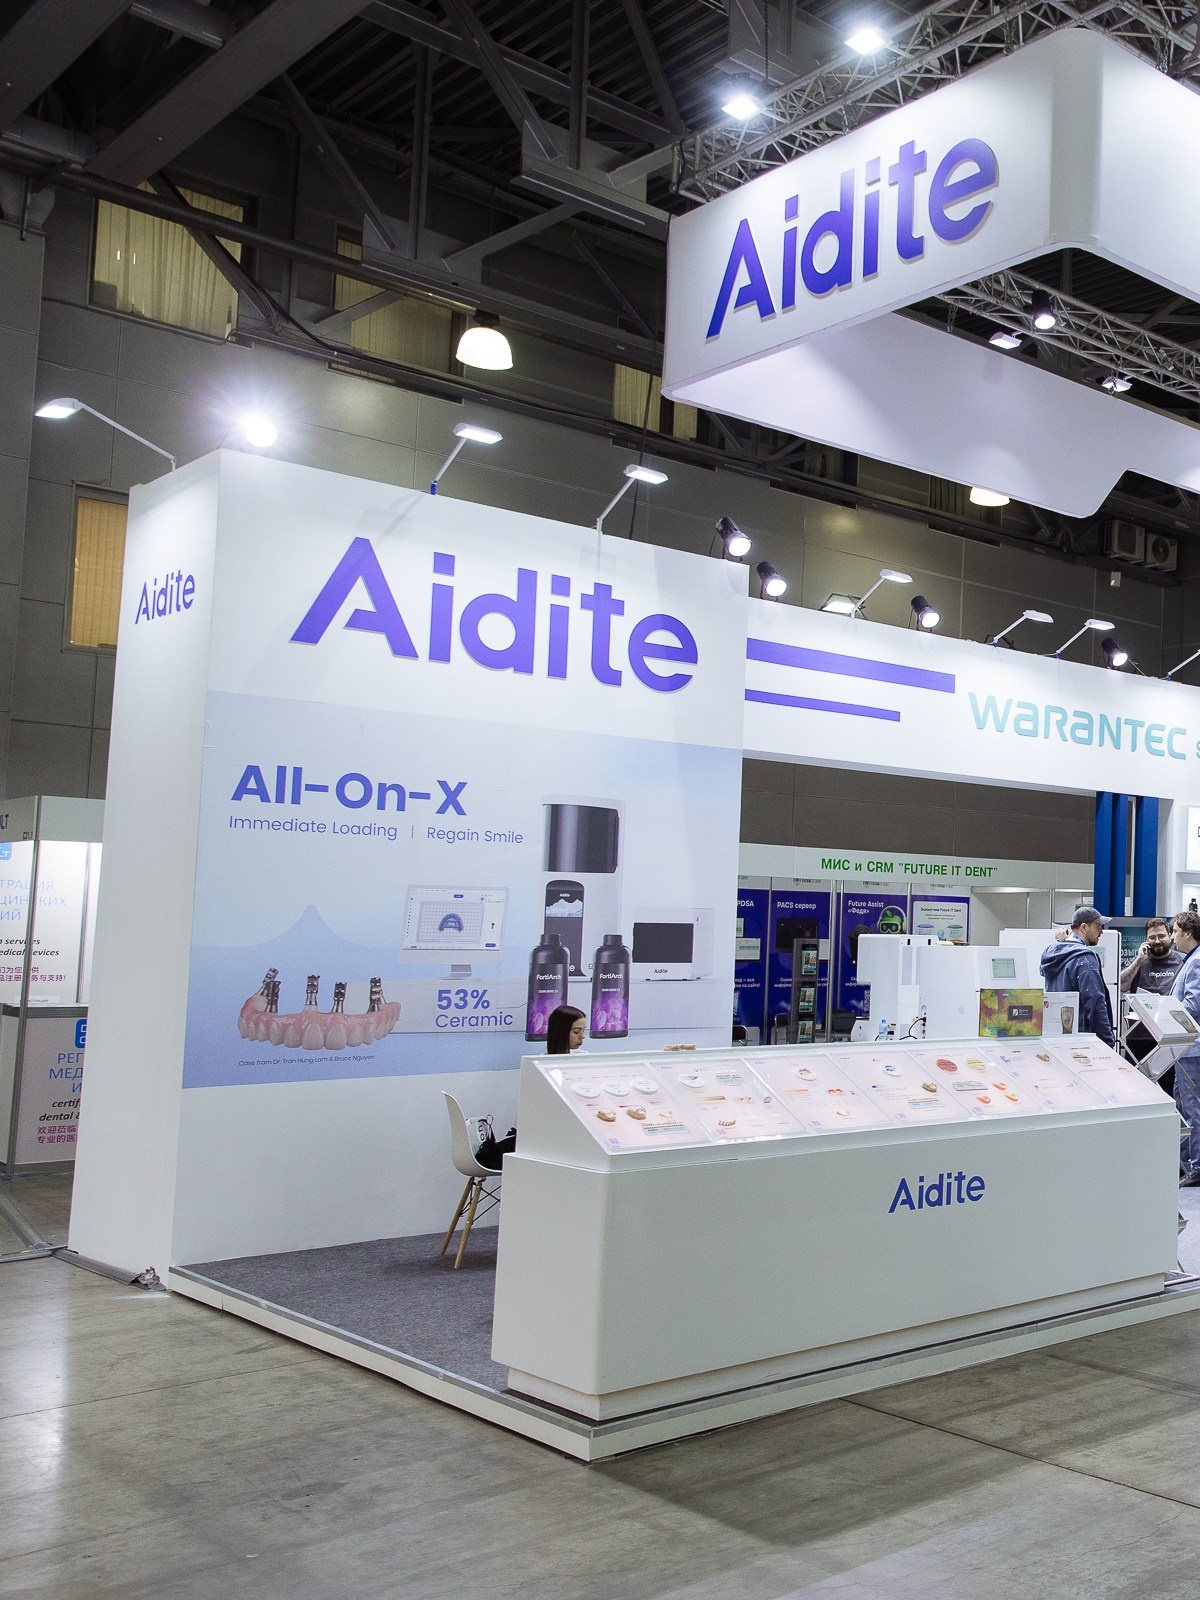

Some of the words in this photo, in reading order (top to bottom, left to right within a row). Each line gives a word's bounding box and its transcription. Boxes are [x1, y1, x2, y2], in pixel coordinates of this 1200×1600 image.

[705, 138, 998, 339] Aidite
[135, 569, 195, 625] Aidite
[290, 536, 699, 693] Aidite
[231, 764, 468, 816] All-On-X
[229, 815, 327, 833] Immediate
[332, 821, 398, 841] Loading
[427, 827, 479, 844] Regain
[484, 830, 524, 844] Smile
[821, 857, 850, 872] МИС
[854, 861, 863, 872] и
[866, 860, 894, 874] CRM
[898, 862, 947, 876] "FUTURE
[951, 865, 962, 876] IT
[965, 866, 998, 879] DENT"
[777, 901, 794, 909] PACS
[795, 903, 817, 912] сервер
[437, 989, 491, 1010] 53%
[435, 1011, 513, 1029] Ceramic
[39, 1111, 74, 1121] dental
[889, 1171, 987, 1214] Aidite
